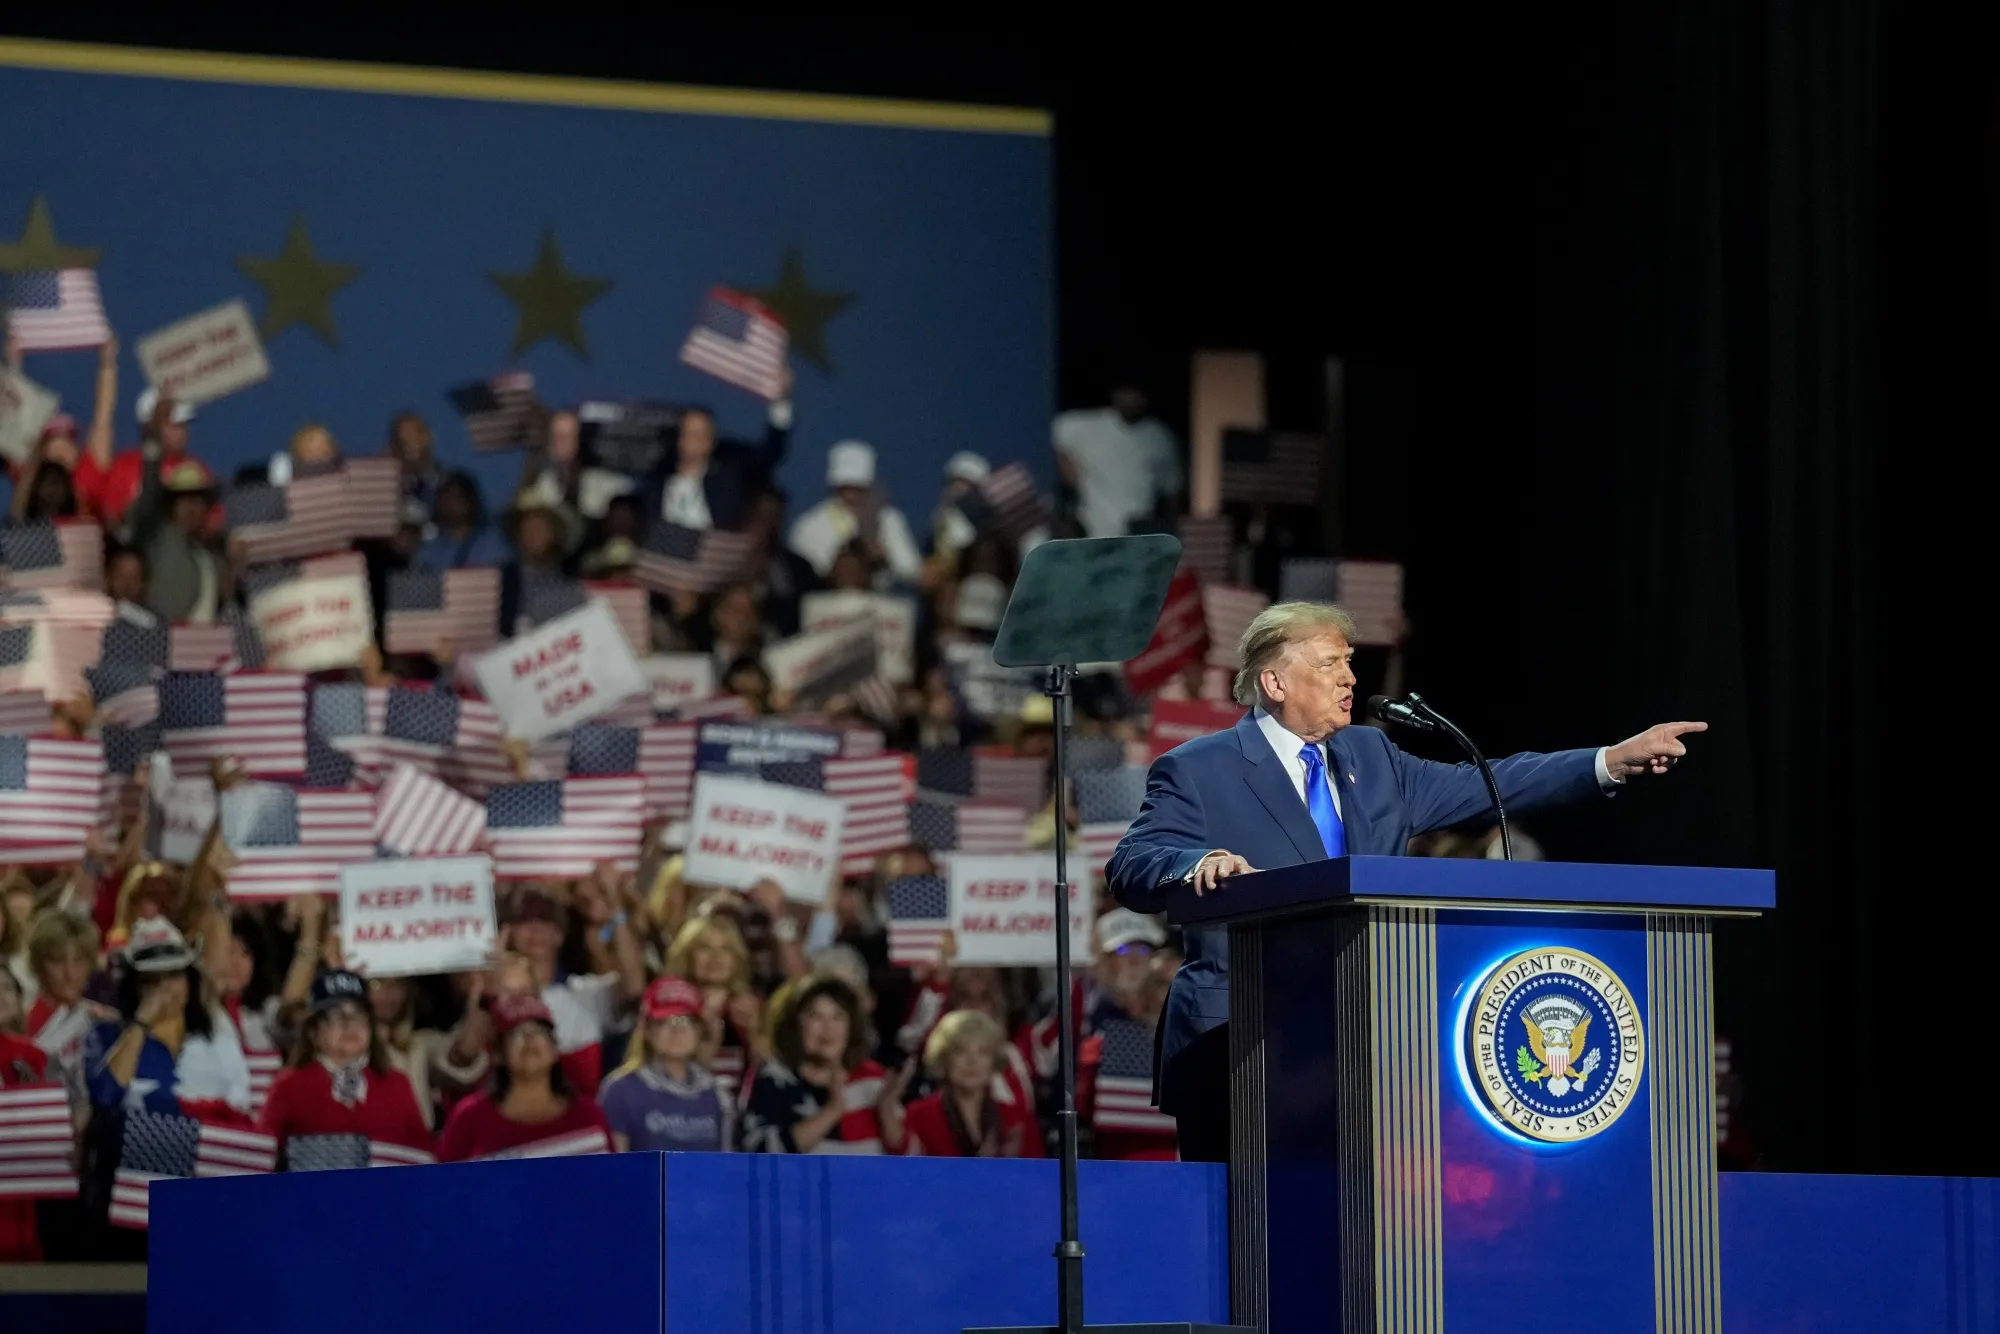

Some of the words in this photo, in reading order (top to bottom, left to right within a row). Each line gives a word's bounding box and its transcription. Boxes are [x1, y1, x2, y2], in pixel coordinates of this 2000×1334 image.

[513, 632, 584, 678] MADE
[544, 682, 595, 716] USA
[710, 804, 775, 827] KEEP
[786, 815, 829, 842] THE
[357, 886, 421, 908] KEEP
[433, 882, 477, 904] THE
[965, 880, 1029, 901] KEEP
[354, 917, 484, 941] MAJORITY
[1560, 957, 1577, 969] OF
[1579, 963, 1602, 983] THE
[1480, 955, 1554, 1036] PRESIDENT
[1603, 982, 1637, 1064] UNITED
[1483, 1044, 1493, 1070] THE
[1487, 1072, 1501, 1090] OF
[1502, 1092, 1544, 1132] SEAL
[1577, 1074, 1632, 1132] STATES
